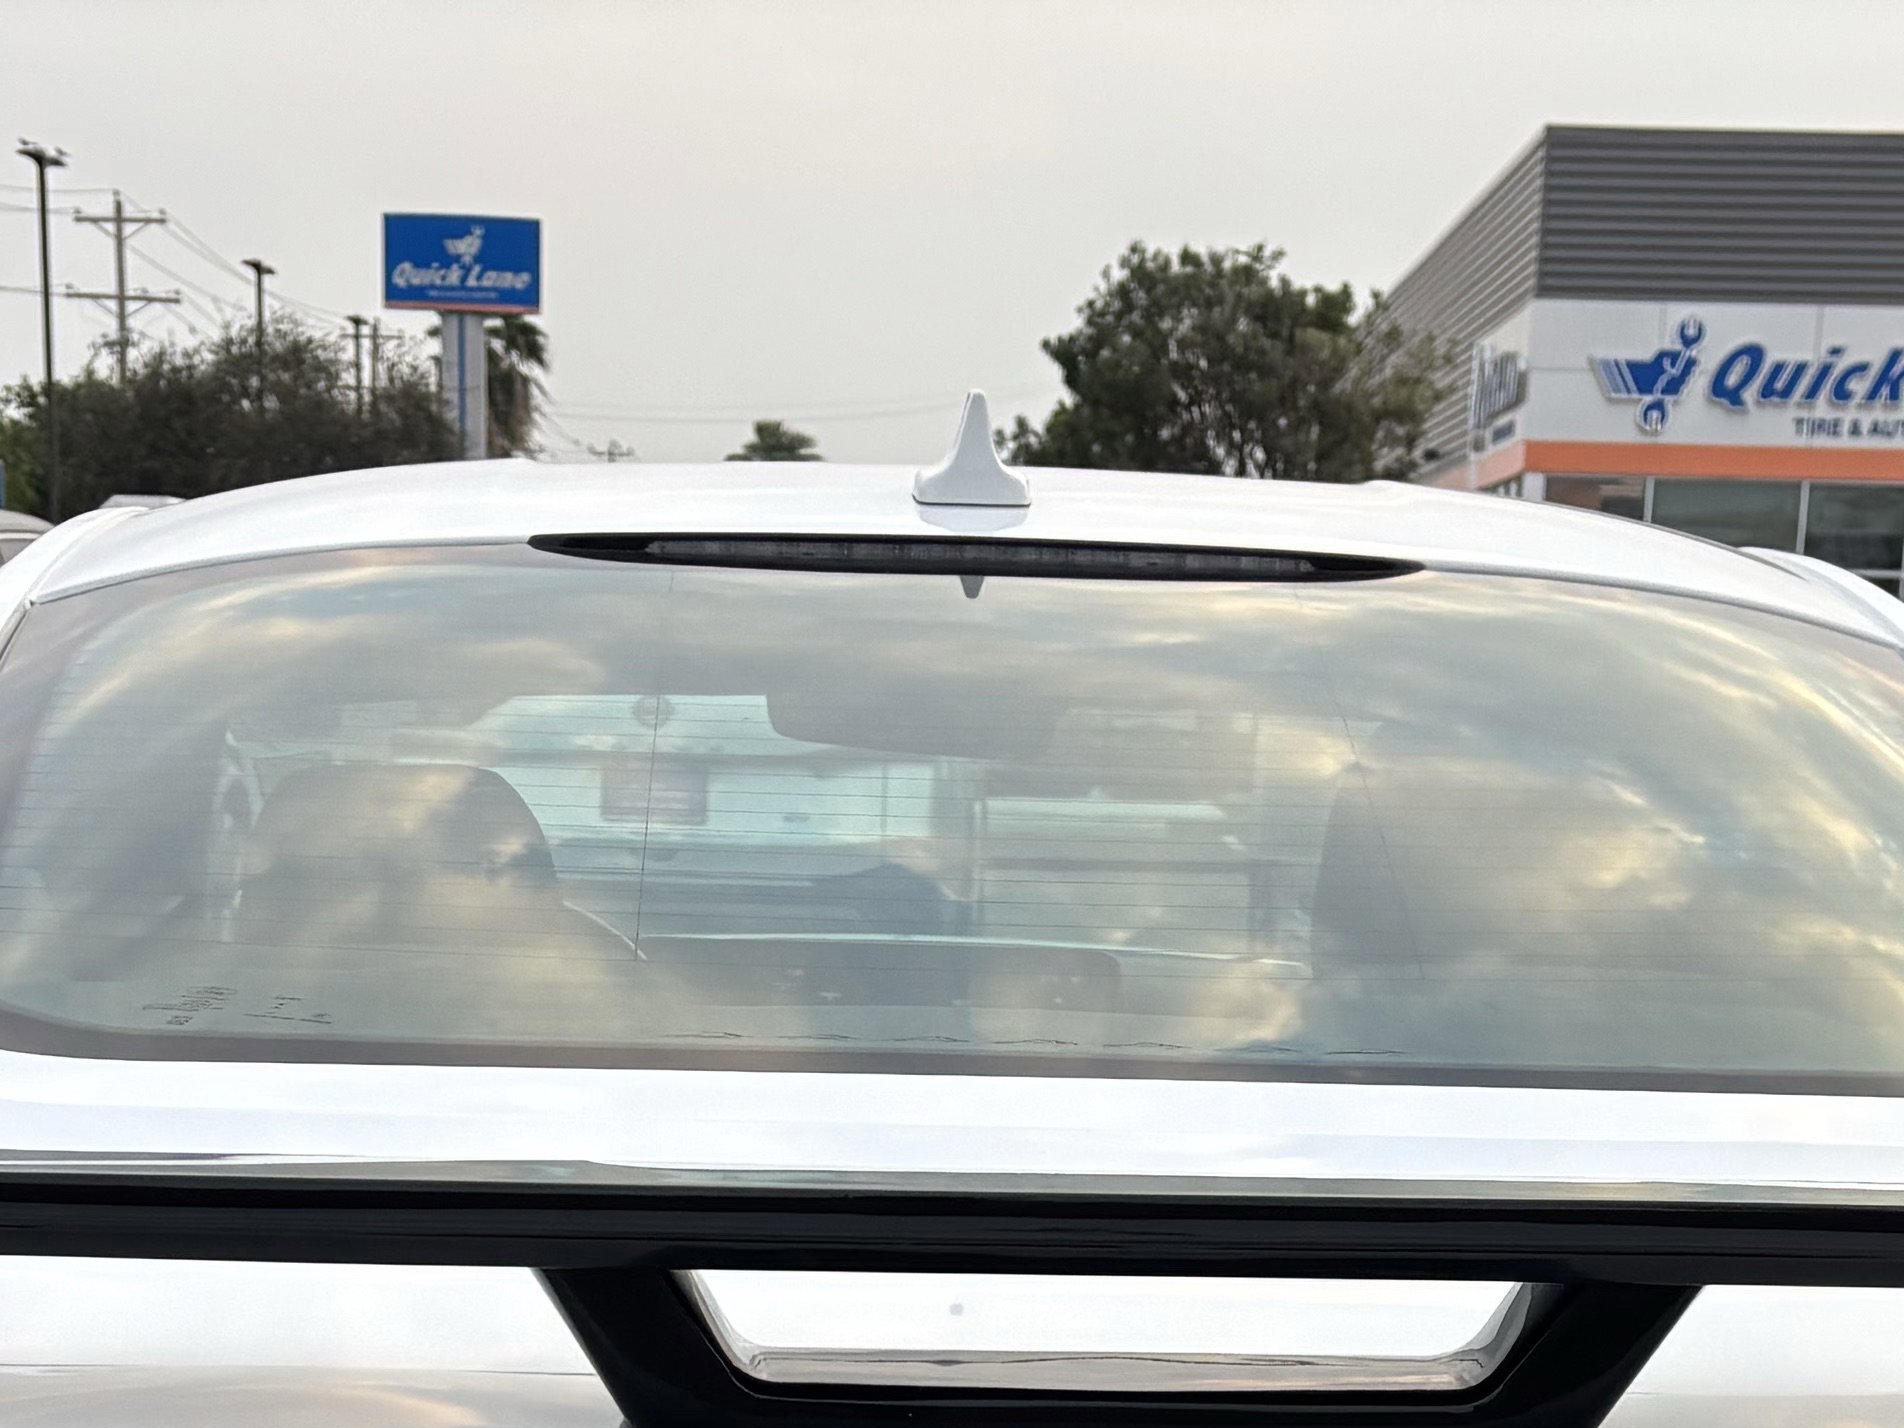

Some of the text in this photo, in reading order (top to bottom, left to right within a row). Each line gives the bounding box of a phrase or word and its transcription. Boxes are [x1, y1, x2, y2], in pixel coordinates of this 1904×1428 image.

[392, 261, 532, 289] Quick Lane
[1793, 417, 1843, 438] TIRE
[1848, 418, 1862, 438] &
